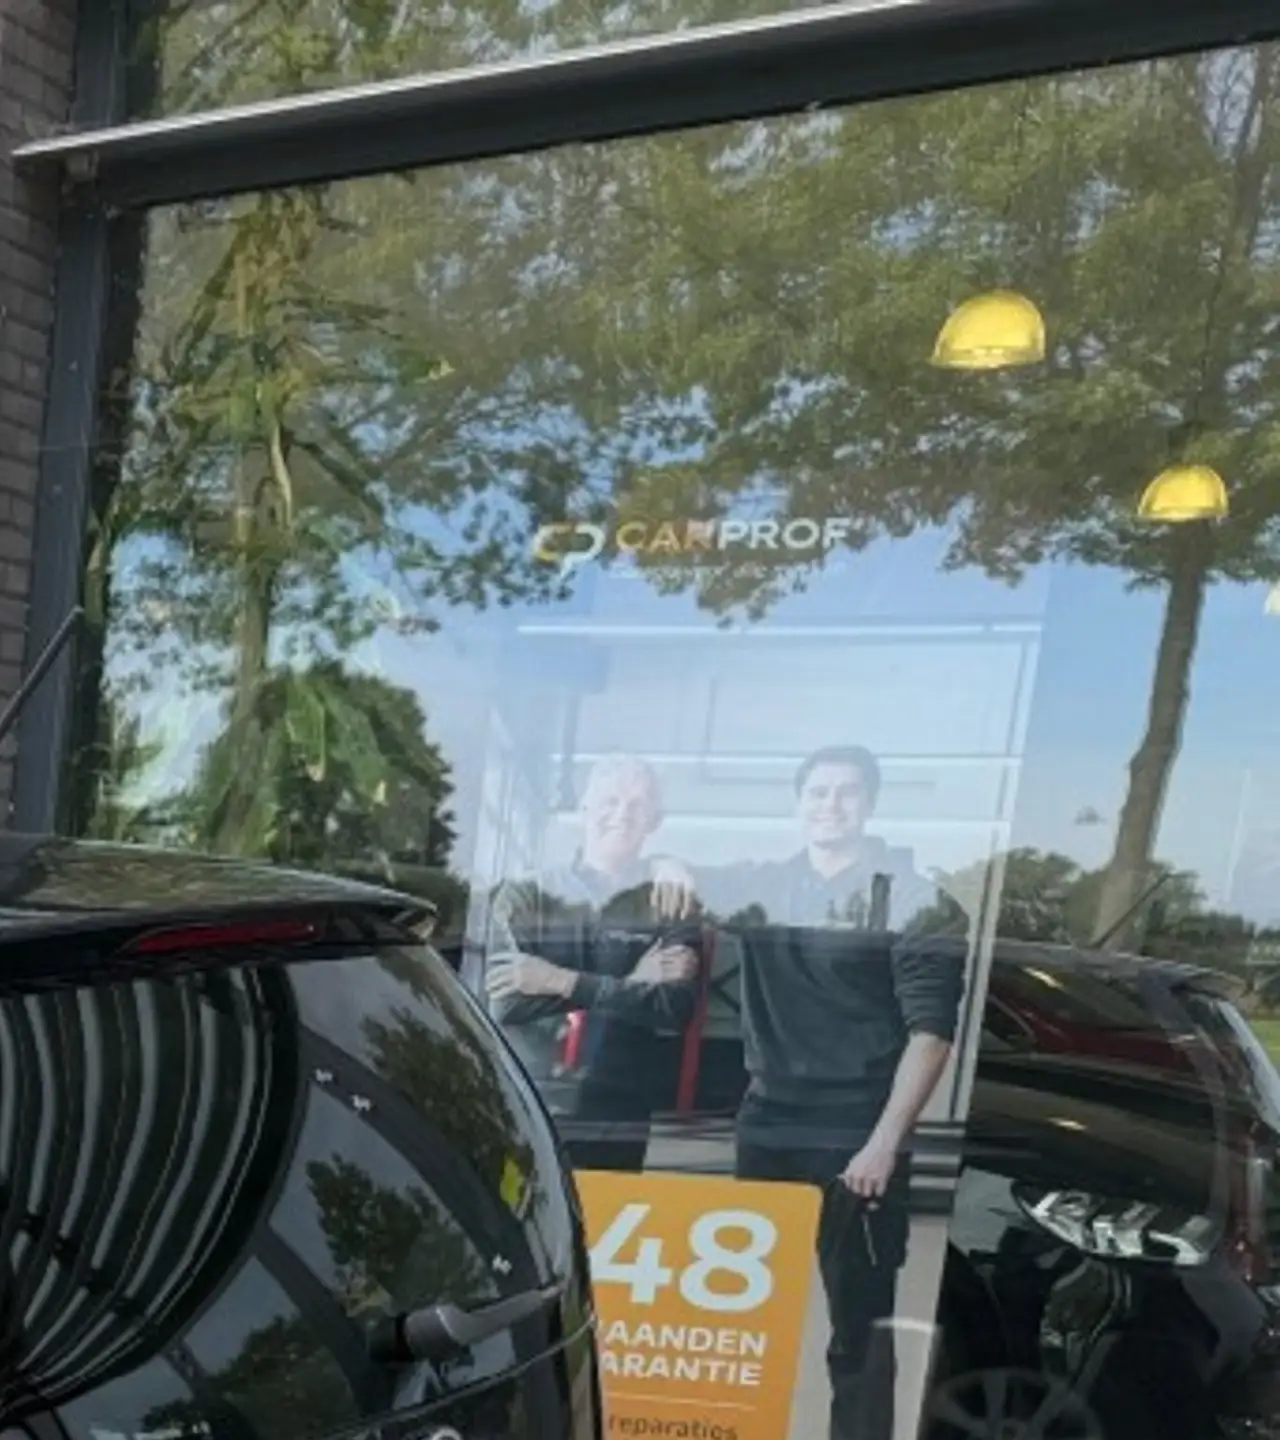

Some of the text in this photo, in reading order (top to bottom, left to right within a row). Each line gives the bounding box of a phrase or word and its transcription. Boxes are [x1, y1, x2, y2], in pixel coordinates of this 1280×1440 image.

[615, 516, 852, 553] CARPROF
[589, 1202, 778, 1312] 48
[596, 1319, 768, 1358] AANDEN
[599, 1350, 764, 1386] ARANTIE
